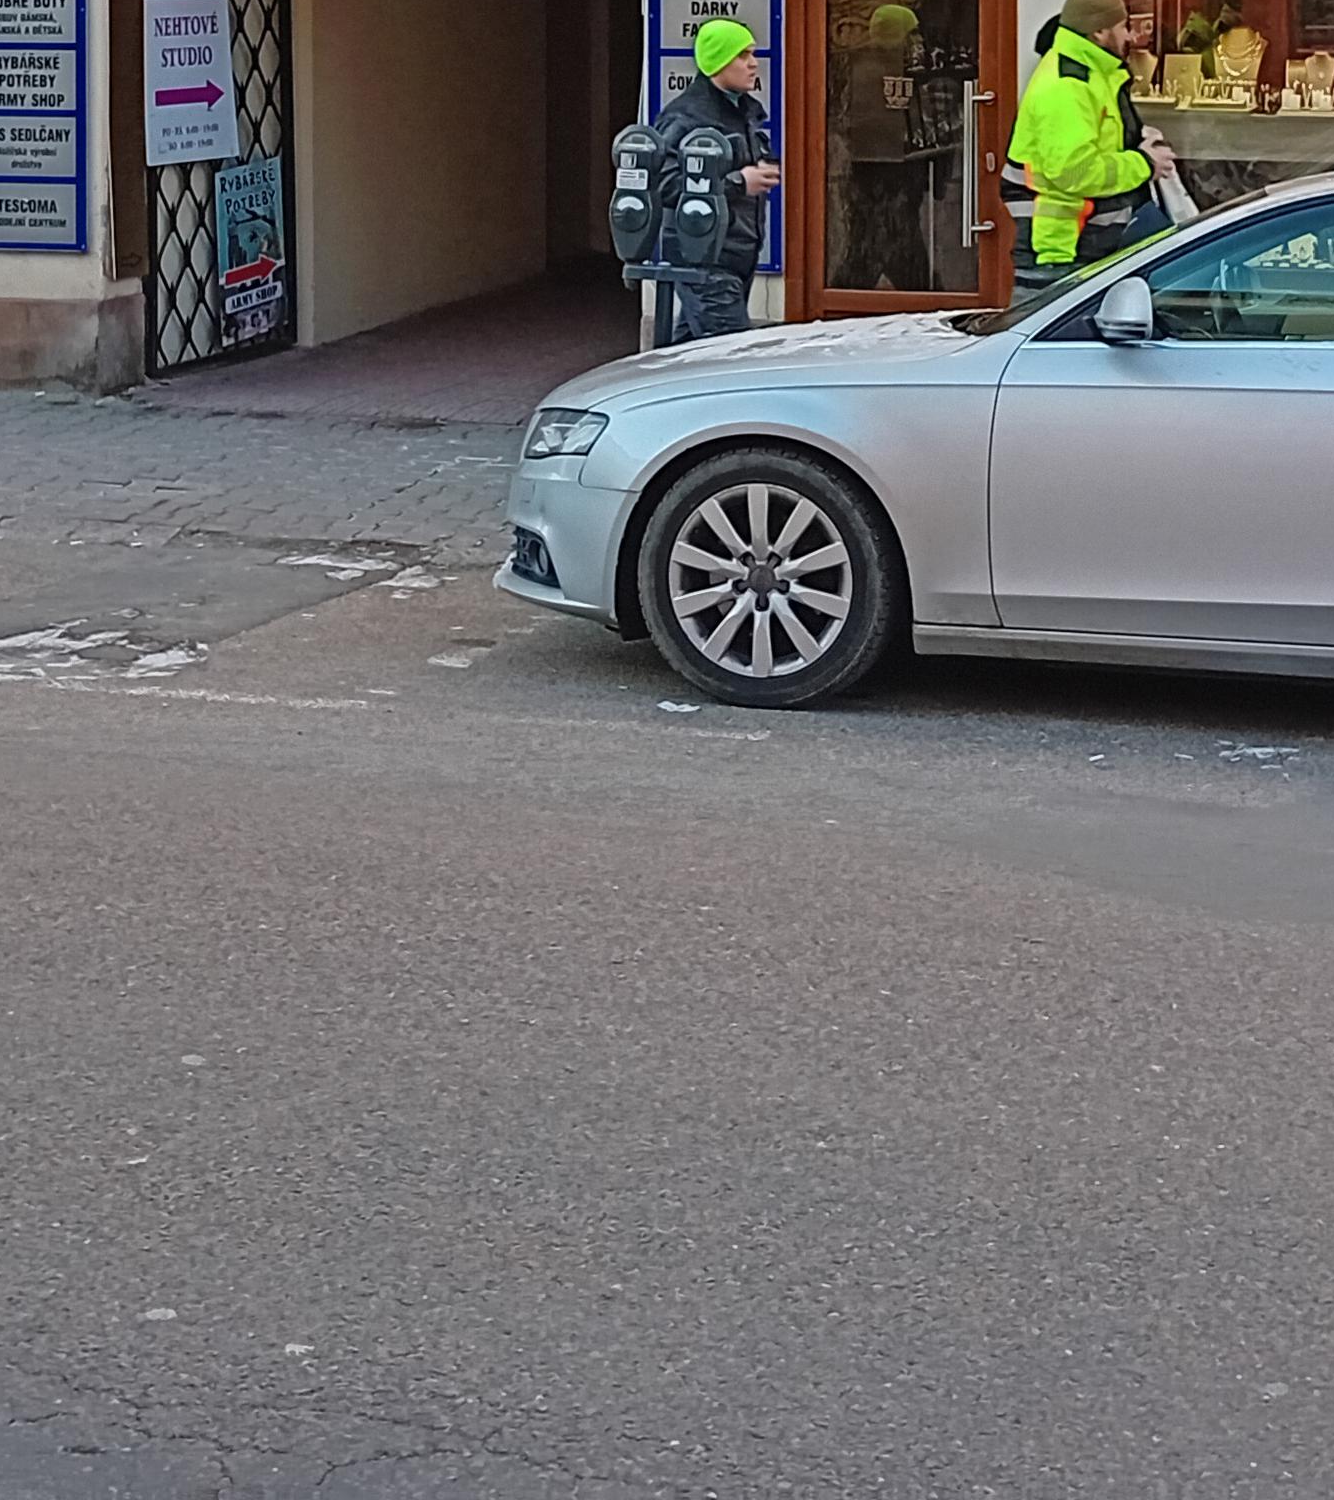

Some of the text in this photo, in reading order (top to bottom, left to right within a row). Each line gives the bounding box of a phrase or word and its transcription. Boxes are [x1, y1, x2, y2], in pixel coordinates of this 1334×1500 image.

[24, 26, 30, 35] A
[154, 12, 219, 38] NEHTOVÉ
[161, 45, 213, 68] STUDIO
[31, 93, 65, 107] SHOP
[10, 124, 71, 142] SEDLČANY
